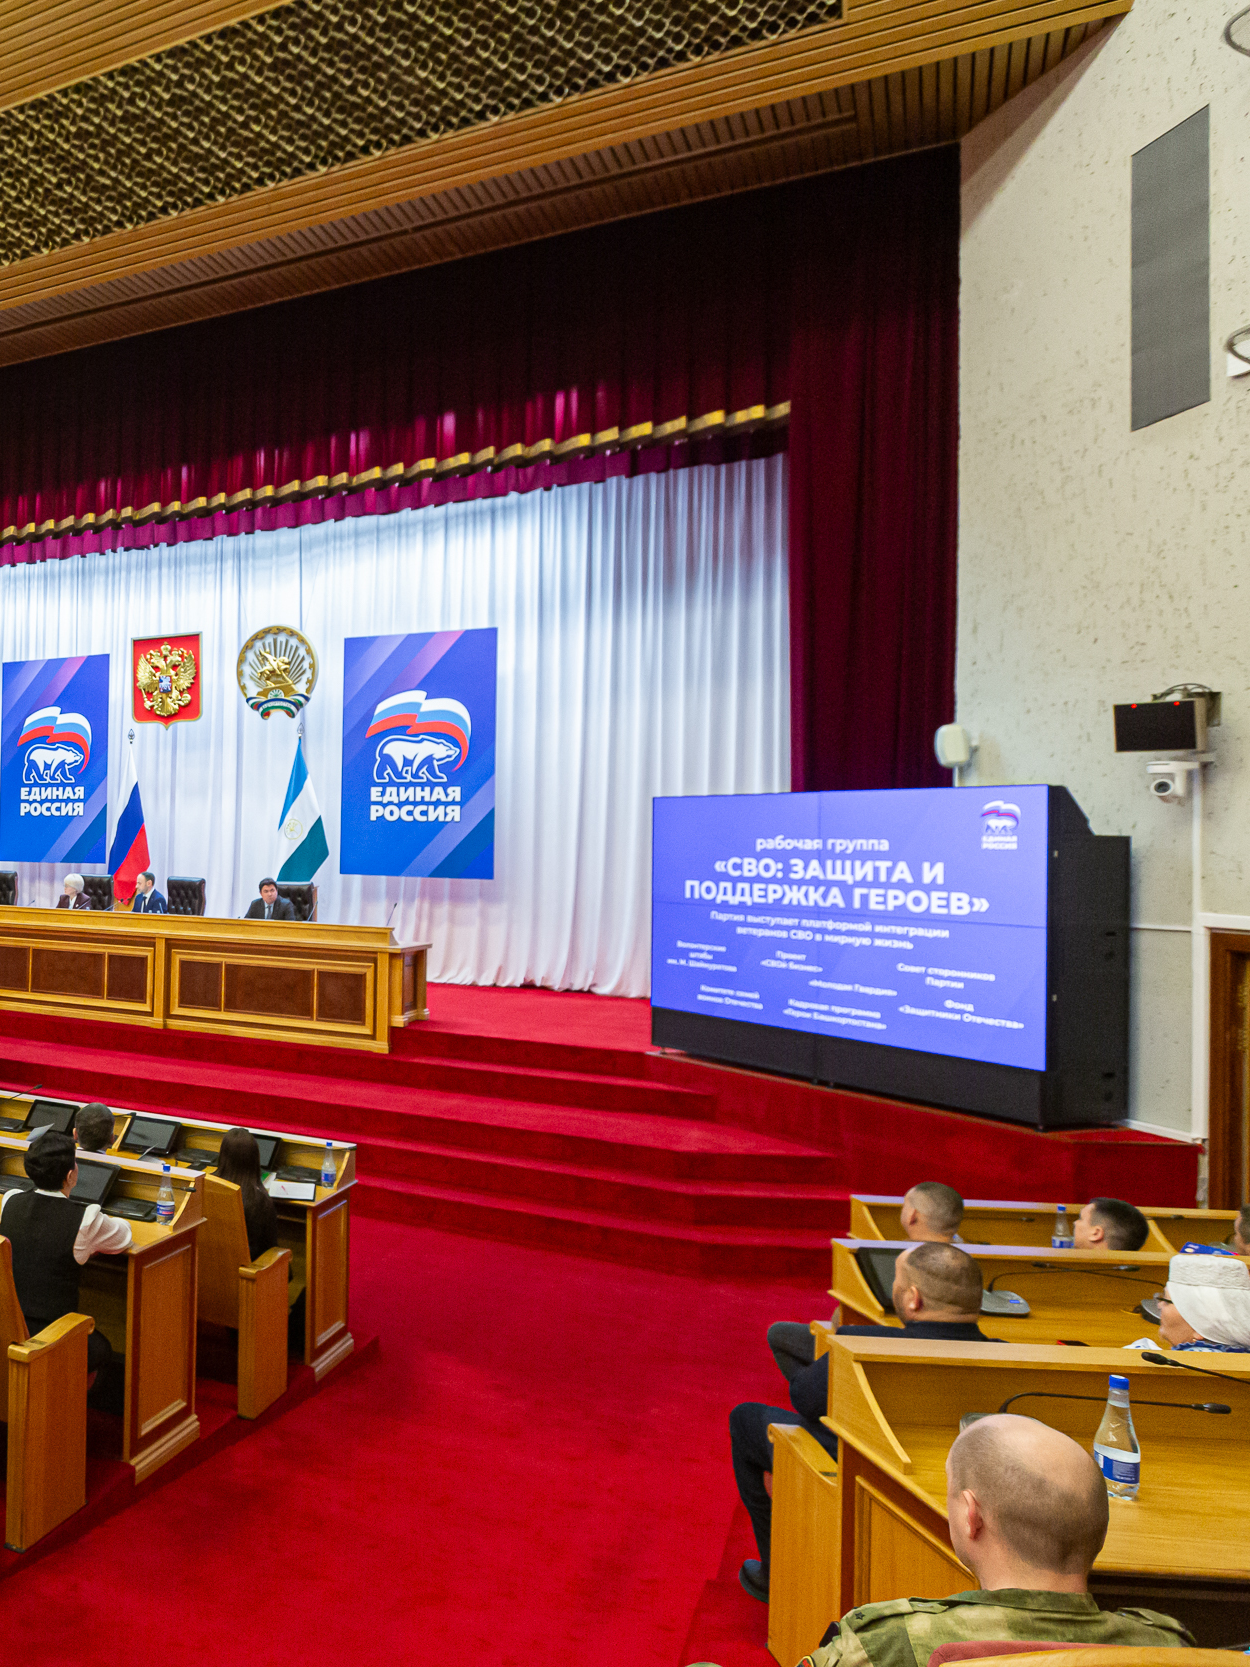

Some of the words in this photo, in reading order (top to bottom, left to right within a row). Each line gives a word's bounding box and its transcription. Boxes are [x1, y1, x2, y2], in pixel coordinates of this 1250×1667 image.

[20, 786, 85, 800] ЕДИНАЯ
[370, 786, 461, 802] ЕДИНАЯ
[20, 802, 84, 816] РОССИЯ
[370, 805, 461, 822] РОССИЯ
[756, 835, 822, 852] рабочая
[827, 836, 890, 853] группа
[714, 857, 784, 879] «СВО:
[789, 858, 914, 885] ЗАЩИТА
[923, 862, 945, 885] И
[684, 880, 845, 908] ПОДДЕРЖКА
[853, 888, 990, 915] ГЕРОЕВ»
[710, 910, 745, 923] Партия
[747, 915, 799, 927] выступает
[801, 918, 872, 932] платформой
[874, 924, 949, 939] интеграции
[736, 926, 788, 939] ветеранов
[790, 930, 813, 941] СВО
[815, 933, 822, 942] в
[824, 934, 871, 947] мирную
[874, 938, 914, 949] жизнь
[896, 962, 926, 974] Совет
[927, 967, 996, 981] сторонников
[925, 976, 964, 989] Партии
